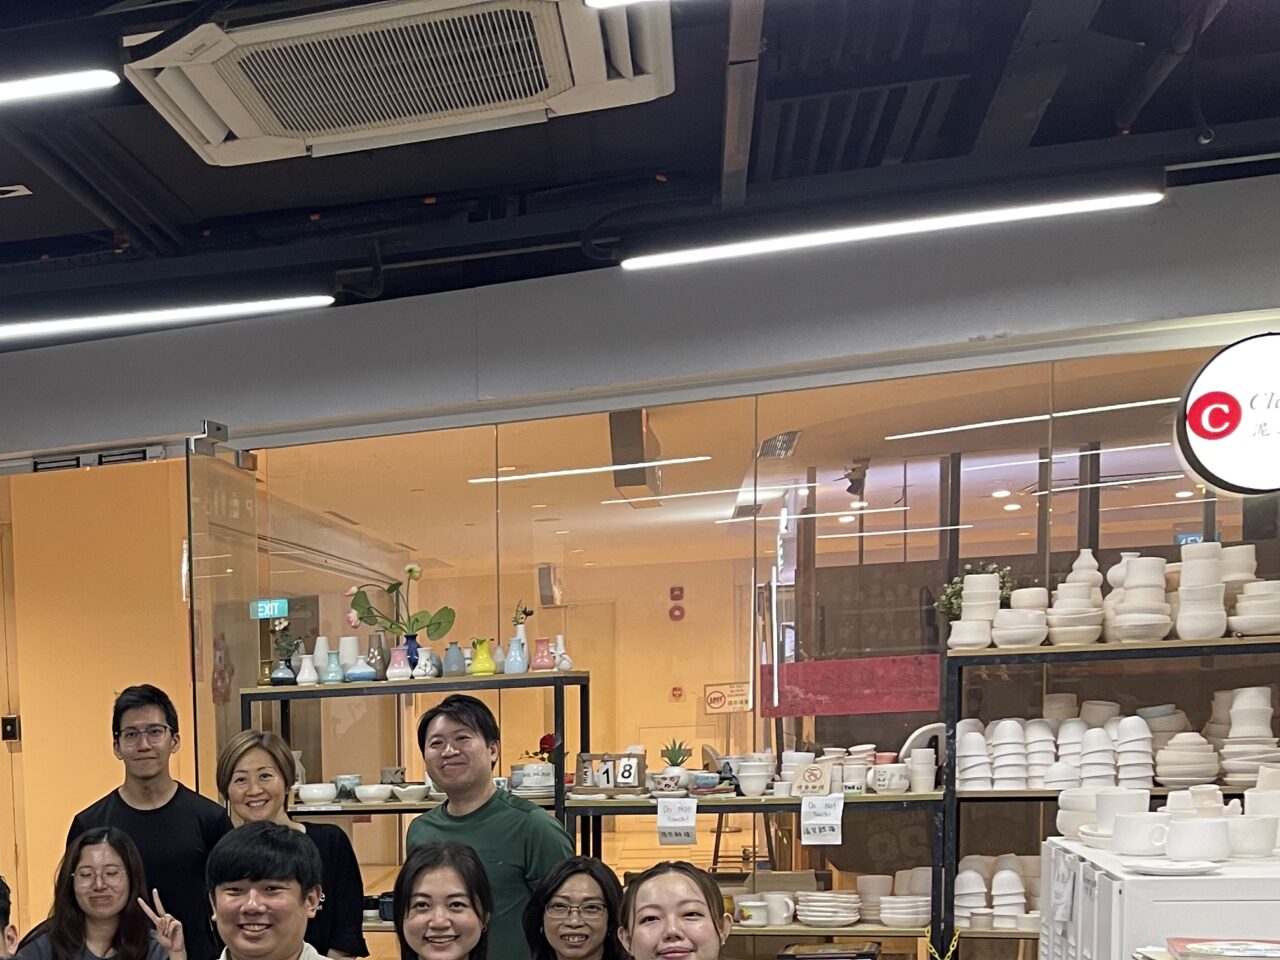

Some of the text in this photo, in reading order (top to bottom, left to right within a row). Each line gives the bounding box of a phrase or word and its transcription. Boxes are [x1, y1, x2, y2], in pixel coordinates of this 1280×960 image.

[1201, 404, 1230, 433] C
[258, 602, 279, 616] EXIT
[602, 768, 610, 784] 1
[621, 764, 633, 779] 8
